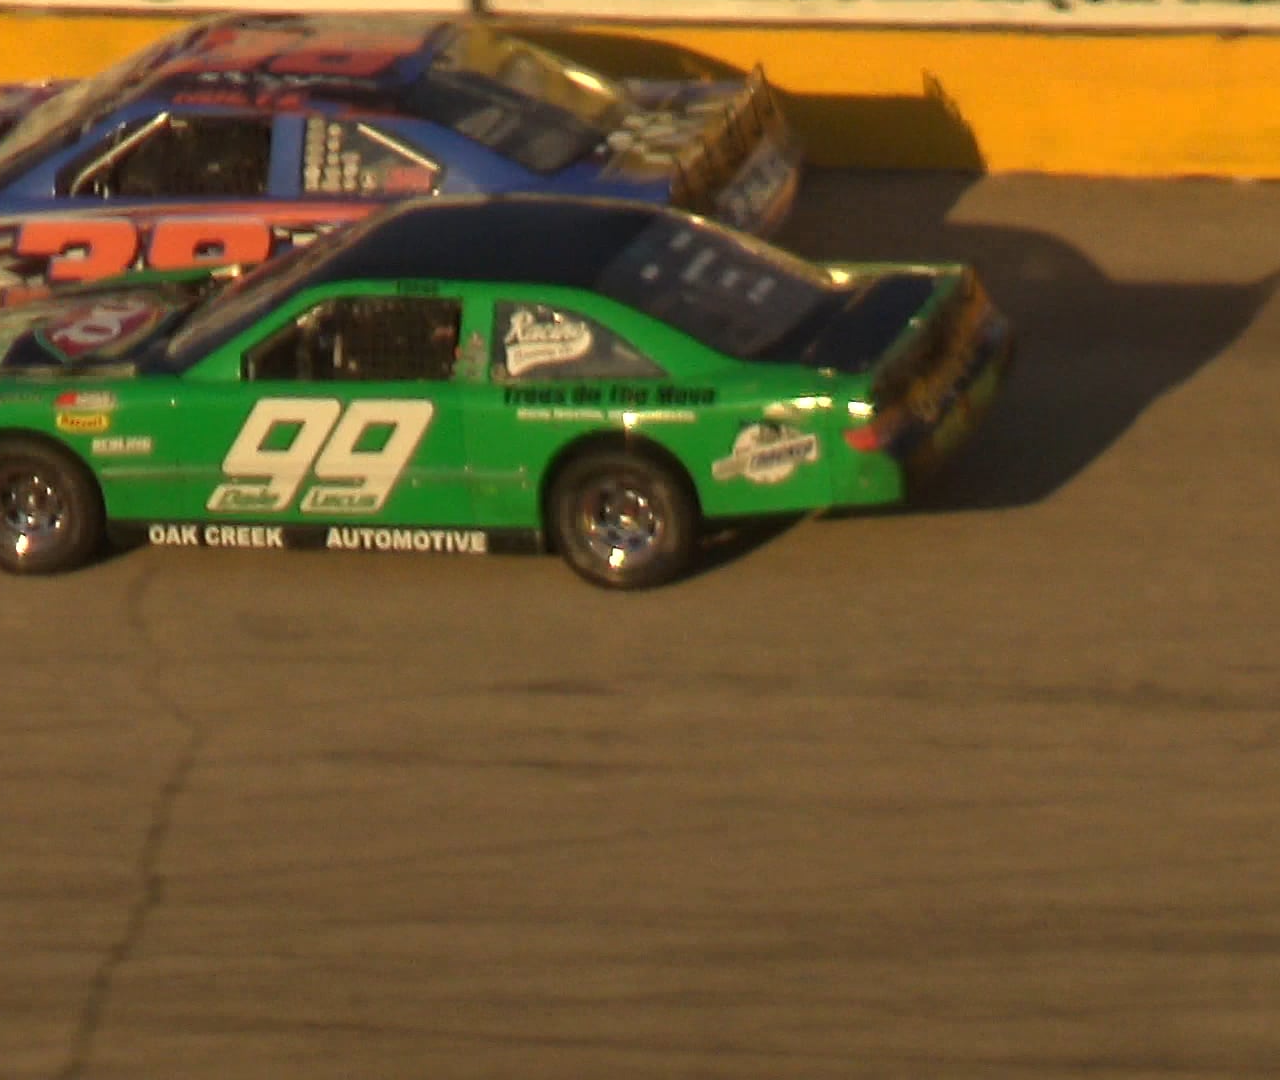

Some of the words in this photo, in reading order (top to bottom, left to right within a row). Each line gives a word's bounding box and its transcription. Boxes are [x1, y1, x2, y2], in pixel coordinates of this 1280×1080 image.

[206, 396, 434, 514] 99
[148, 524, 198, 546] OAK
[204, 526, 284, 549] CREEK
[325, 527, 487, 554] AUTOMOTIVE
